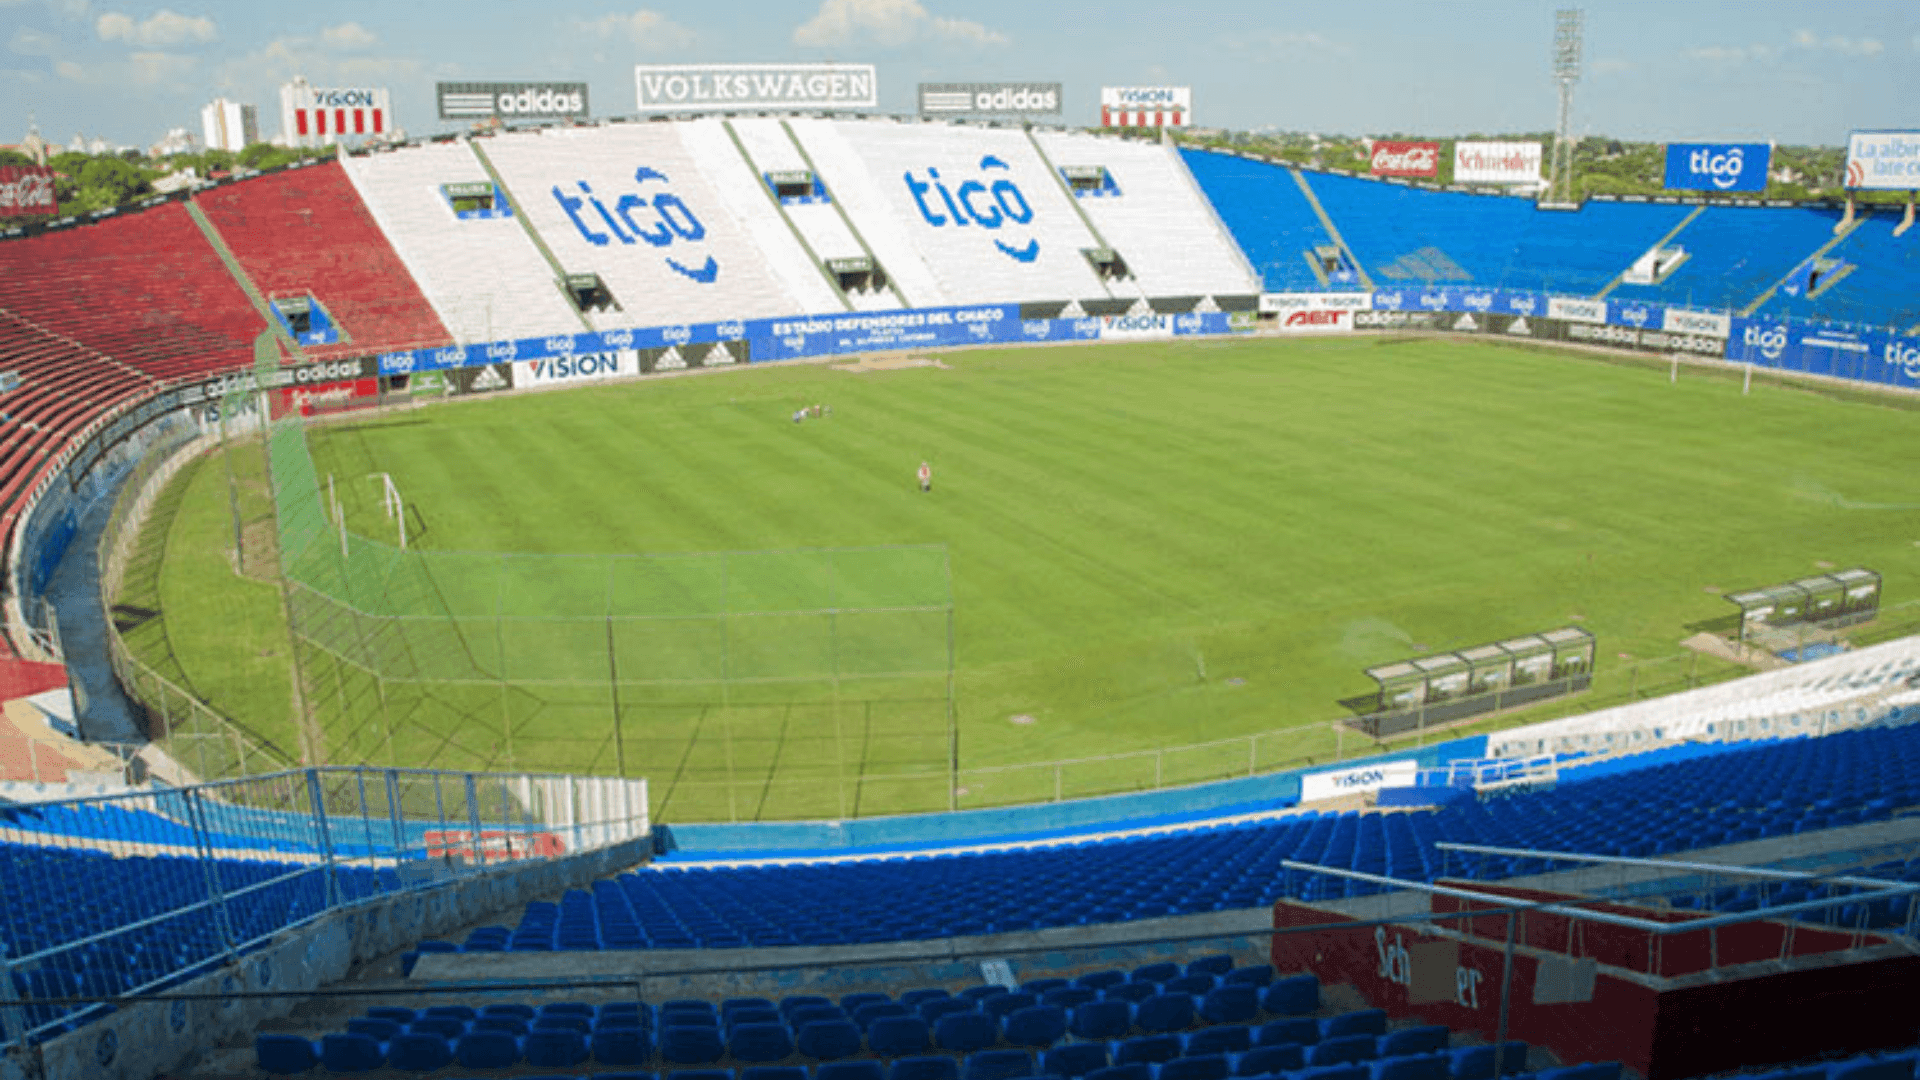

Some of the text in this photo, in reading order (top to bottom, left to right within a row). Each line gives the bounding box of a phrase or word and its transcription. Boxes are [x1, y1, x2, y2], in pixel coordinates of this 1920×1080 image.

[499, 87, 584, 113] adidas
[642, 74, 870, 100] VOLKSWAGEN
[976, 87, 1057, 110] adidas
[296, 359, 363, 384] adidas
[529, 352, 619, 380] VISION
